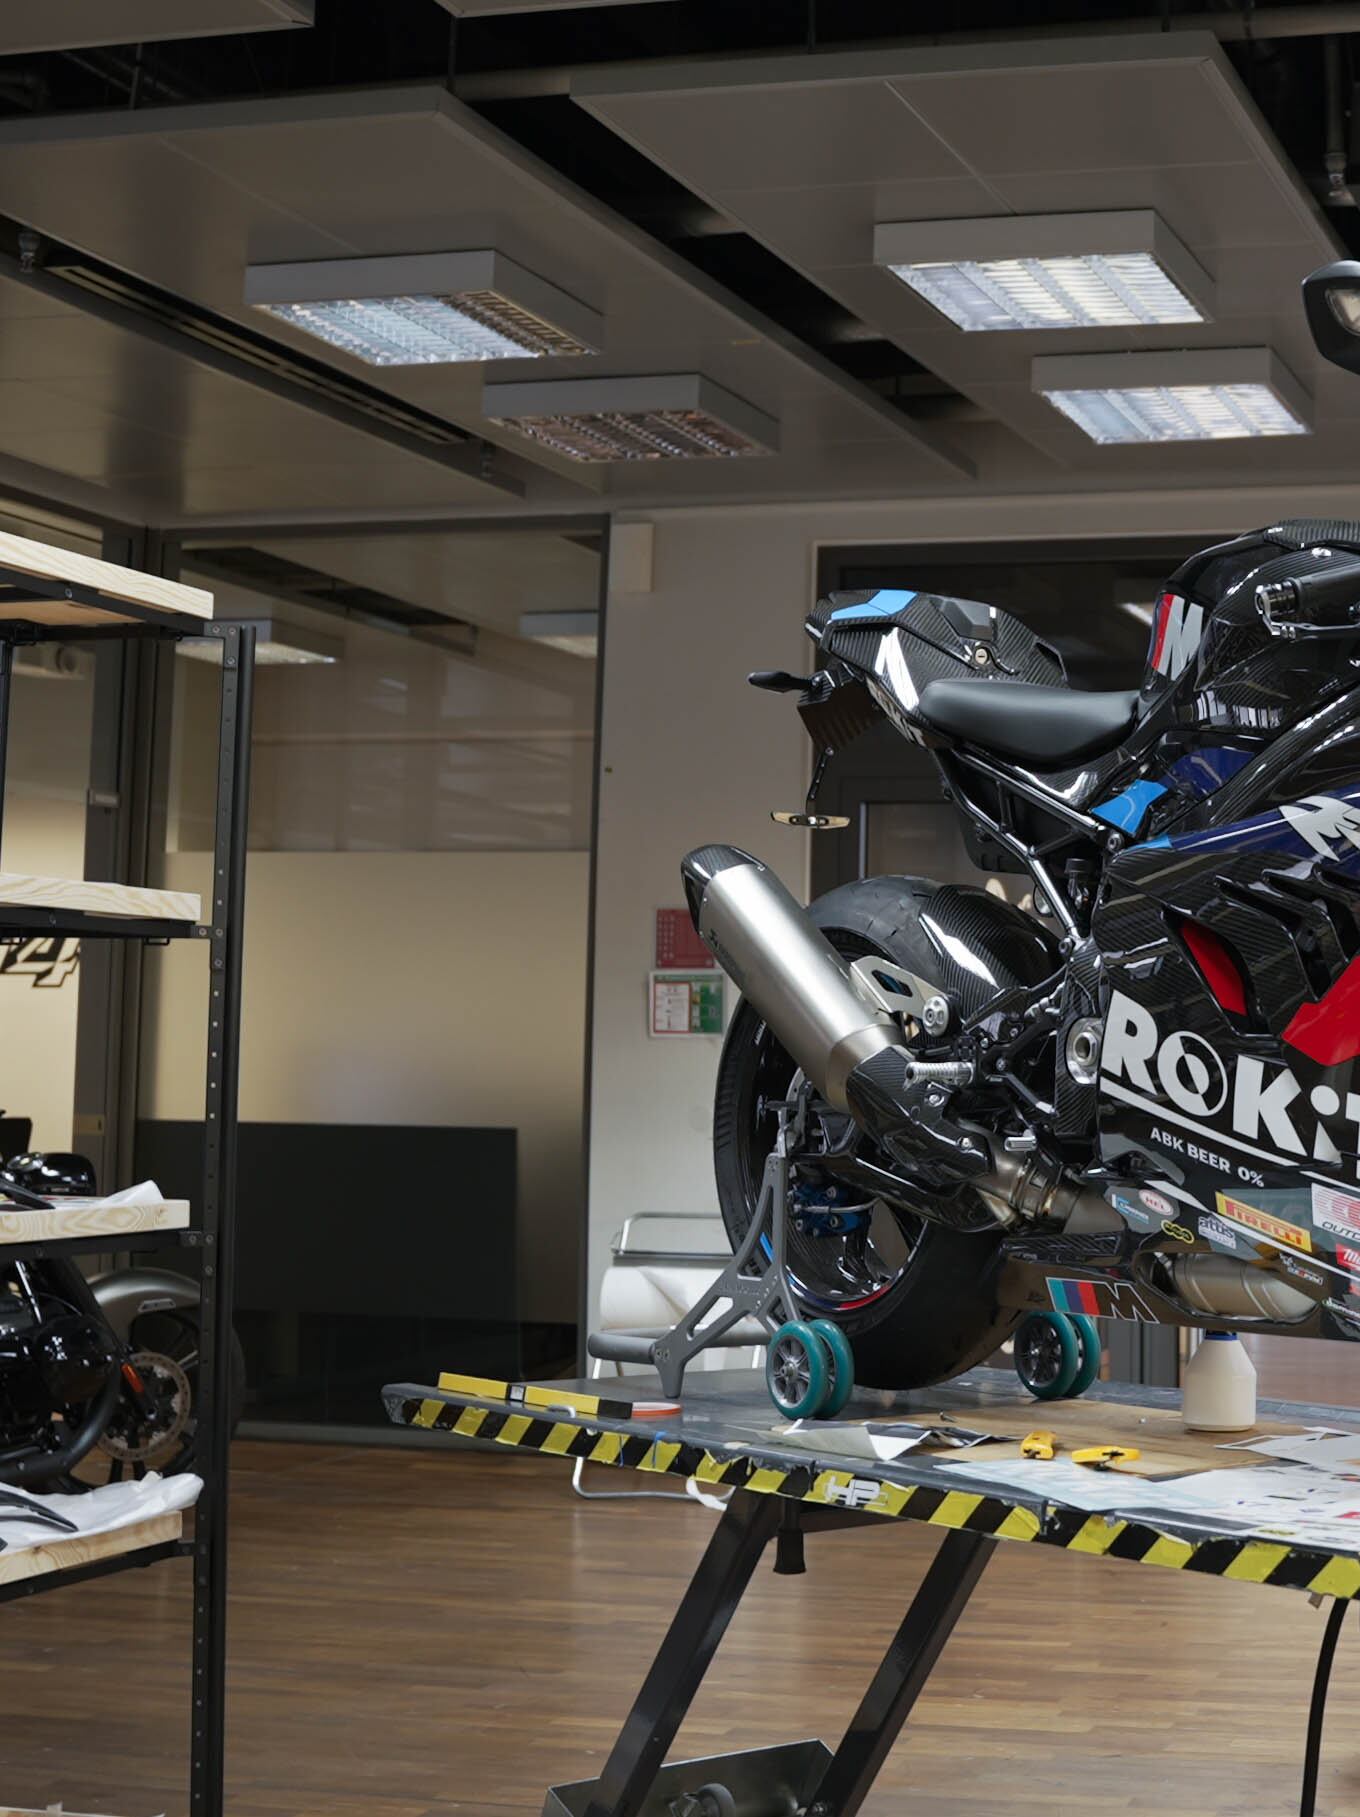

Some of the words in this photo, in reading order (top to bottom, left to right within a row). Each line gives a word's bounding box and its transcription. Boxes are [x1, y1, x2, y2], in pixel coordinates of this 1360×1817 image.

[1150, 1127, 1185, 1153] ABK
[1186, 1142, 1232, 1174] BEER
[1237, 1166, 1265, 1188] 0%
[1224, 1199, 1304, 1247] PIRELLI
